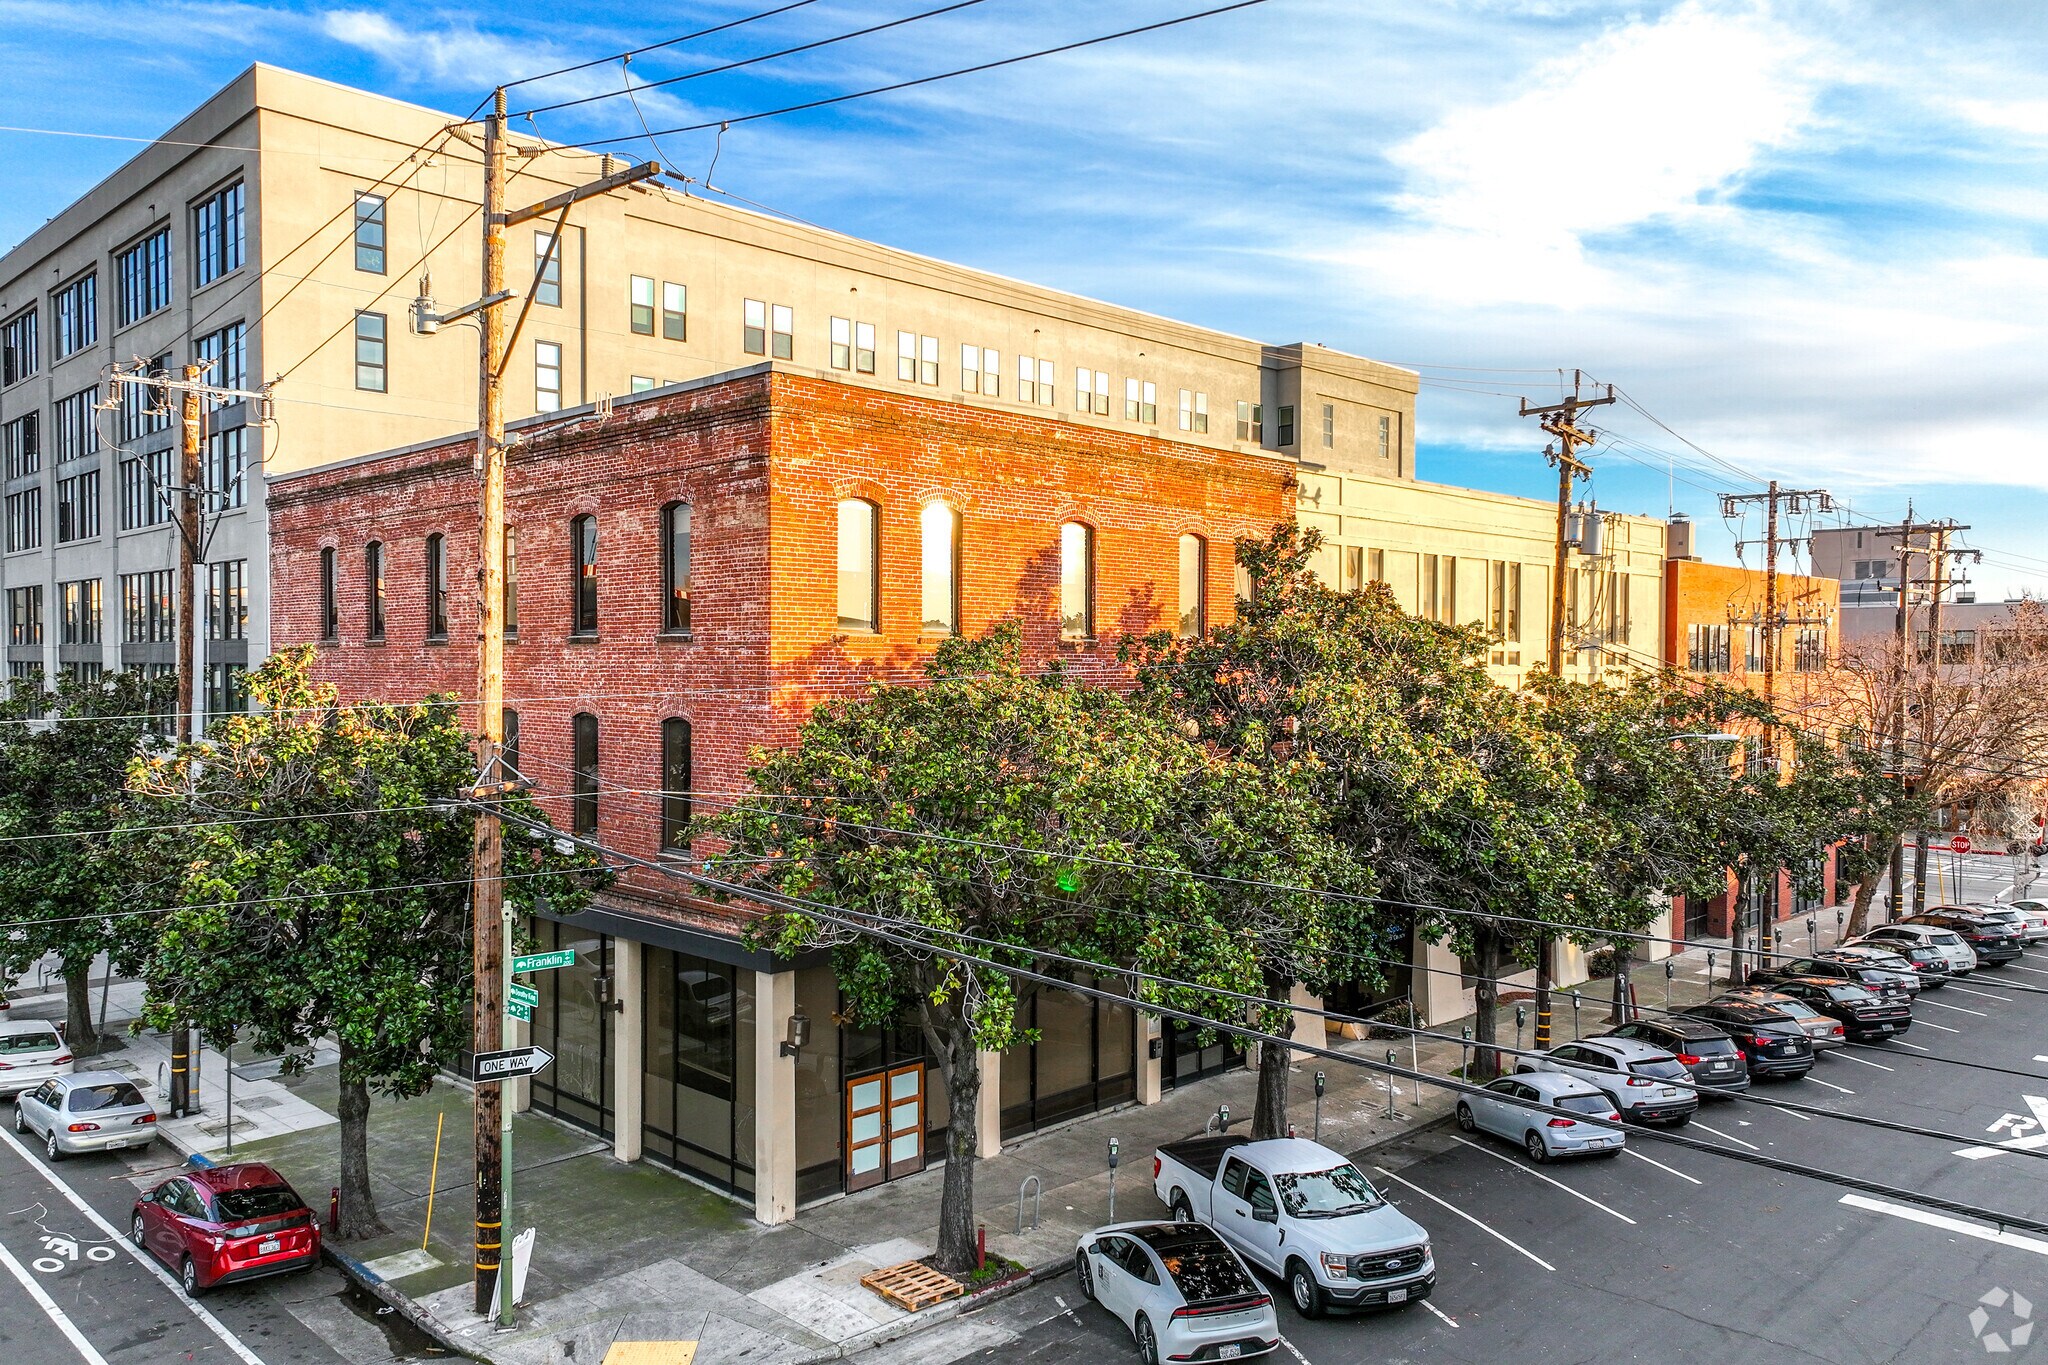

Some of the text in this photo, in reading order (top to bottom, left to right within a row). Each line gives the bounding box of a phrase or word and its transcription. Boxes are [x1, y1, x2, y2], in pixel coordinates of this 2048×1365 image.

[1952, 841, 1970, 849] STOP
[527, 955, 563, 968] Franklin
[484, 1056, 531, 1073] ONE WAY
